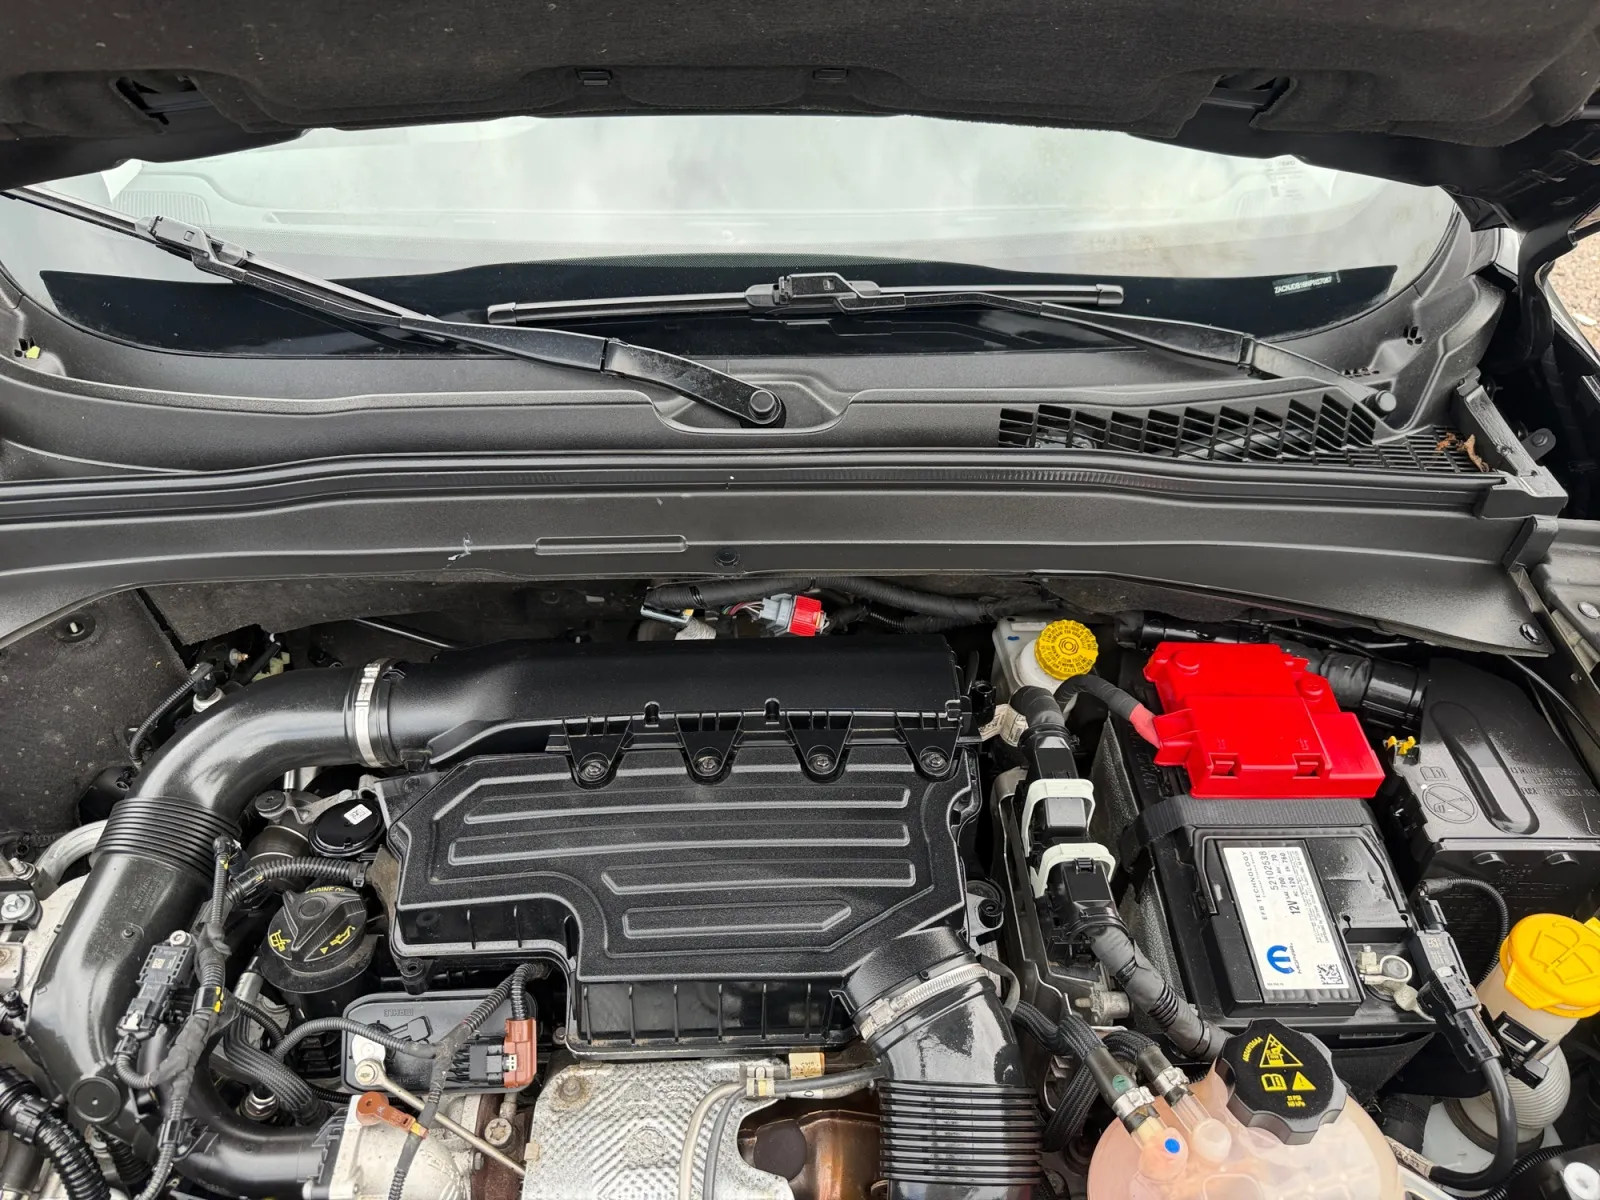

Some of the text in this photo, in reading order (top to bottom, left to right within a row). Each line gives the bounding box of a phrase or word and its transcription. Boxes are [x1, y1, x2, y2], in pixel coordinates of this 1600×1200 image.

[1259, 851, 1279, 891] 52102538
[1241, 851, 1268, 920] EFB TECHNOLOGY
[1279, 878, 1288, 888] 700
[1288, 878, 1297, 888] 120
[304, 886, 335, 894] NGINE
[1287, 901, 1301, 915] 12V
